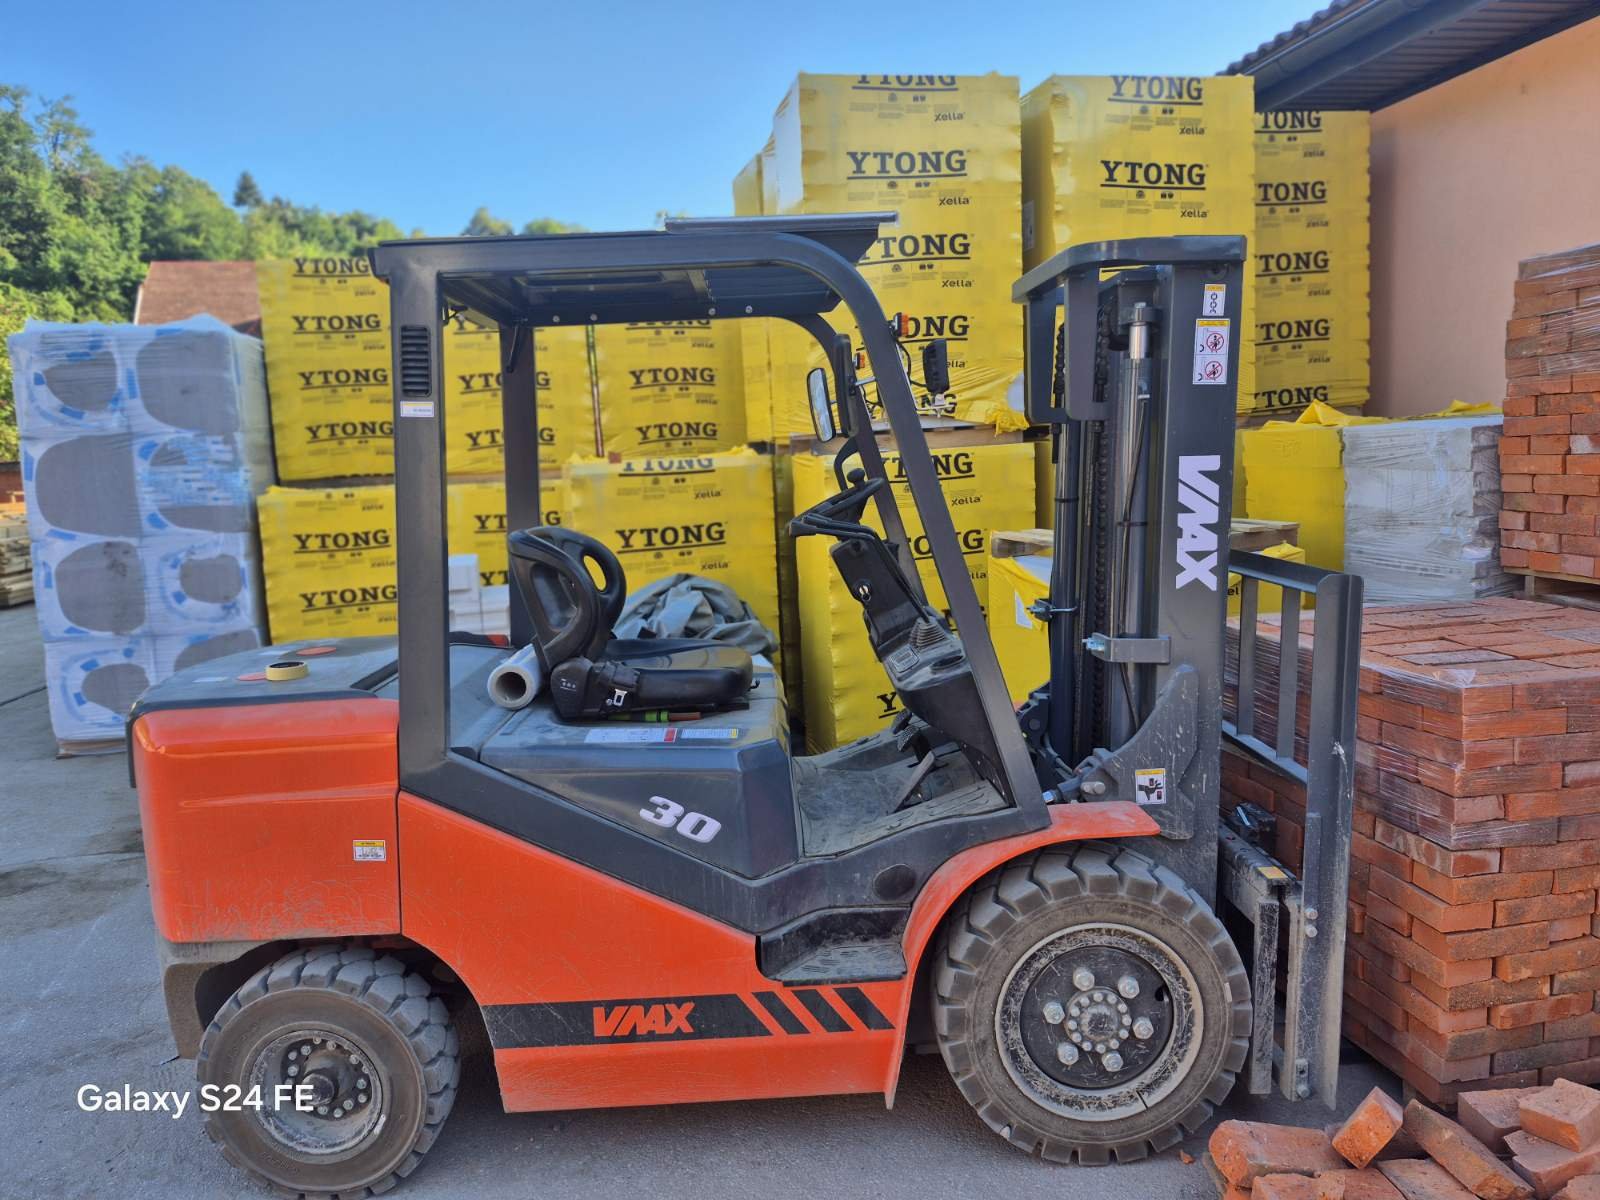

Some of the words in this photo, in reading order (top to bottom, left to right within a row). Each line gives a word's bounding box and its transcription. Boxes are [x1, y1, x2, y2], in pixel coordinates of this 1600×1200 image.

[1111, 75, 1203, 100] YTONG
[934, 112, 964, 122] xella
[1261, 111, 1322, 129] TONG
[846, 150, 967, 174] YTONG
[1100, 160, 1206, 185] YTONG
[938, 196, 970, 206] xella
[1258, 181, 1327, 201] TONG
[868, 233, 970, 260] TONG
[294, 257, 369, 273] YTONG
[1256, 250, 1330, 272] TONG
[941, 279, 973, 288] xella
[292, 314, 381, 331] YTONG
[1256, 318, 1330, 341] TONG
[298, 367, 388, 386] YTONG
[630, 367, 716, 385] YTONG
[305, 421, 394, 440] YTONG
[636, 422, 718, 440] YTONG
[951, 495, 982, 506] xella
[1176, 455, 1220, 591] VMAX
[293, 529, 390, 549] YTONG
[616, 522, 726, 549] YTONG
[299, 585, 398, 609] YTONG
[639, 795, 722, 843] 30
[593, 1001, 695, 1037] VMAX
